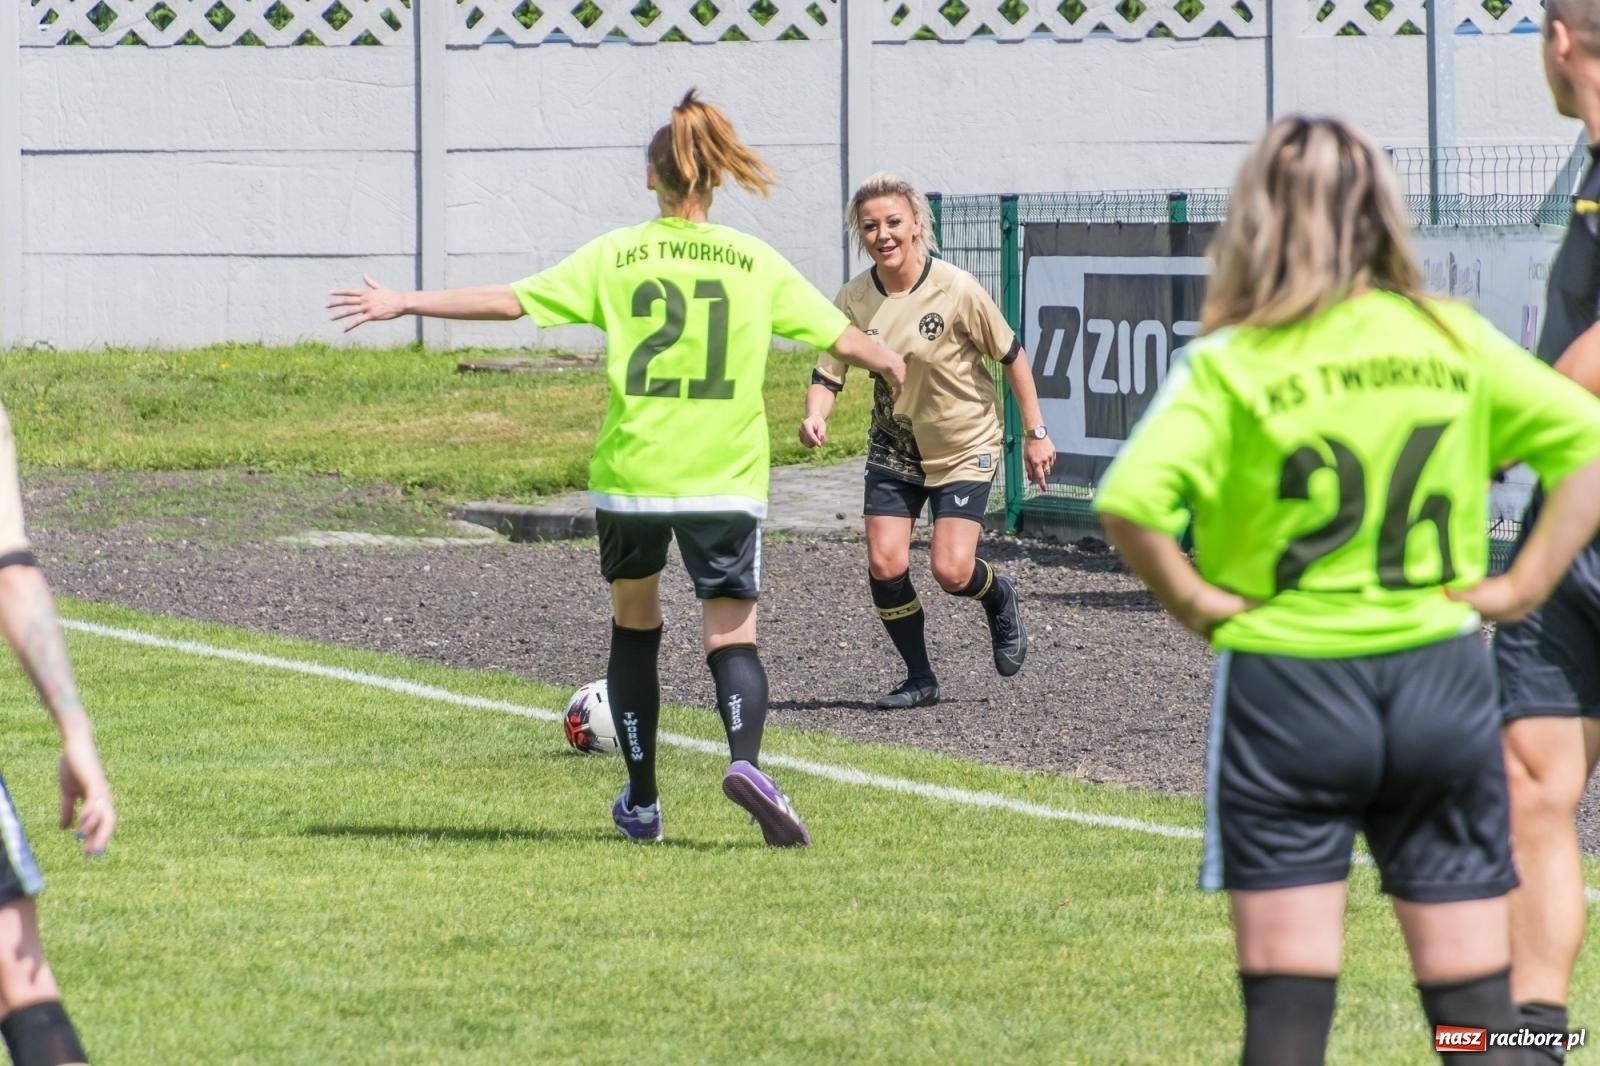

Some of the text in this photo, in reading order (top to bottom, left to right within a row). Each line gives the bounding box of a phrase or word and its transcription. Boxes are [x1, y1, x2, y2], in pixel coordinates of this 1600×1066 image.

[615, 240, 754, 273] LKS TWORKÓW
[625, 277, 737, 400] 21
[1274, 418, 1456, 593] 26
